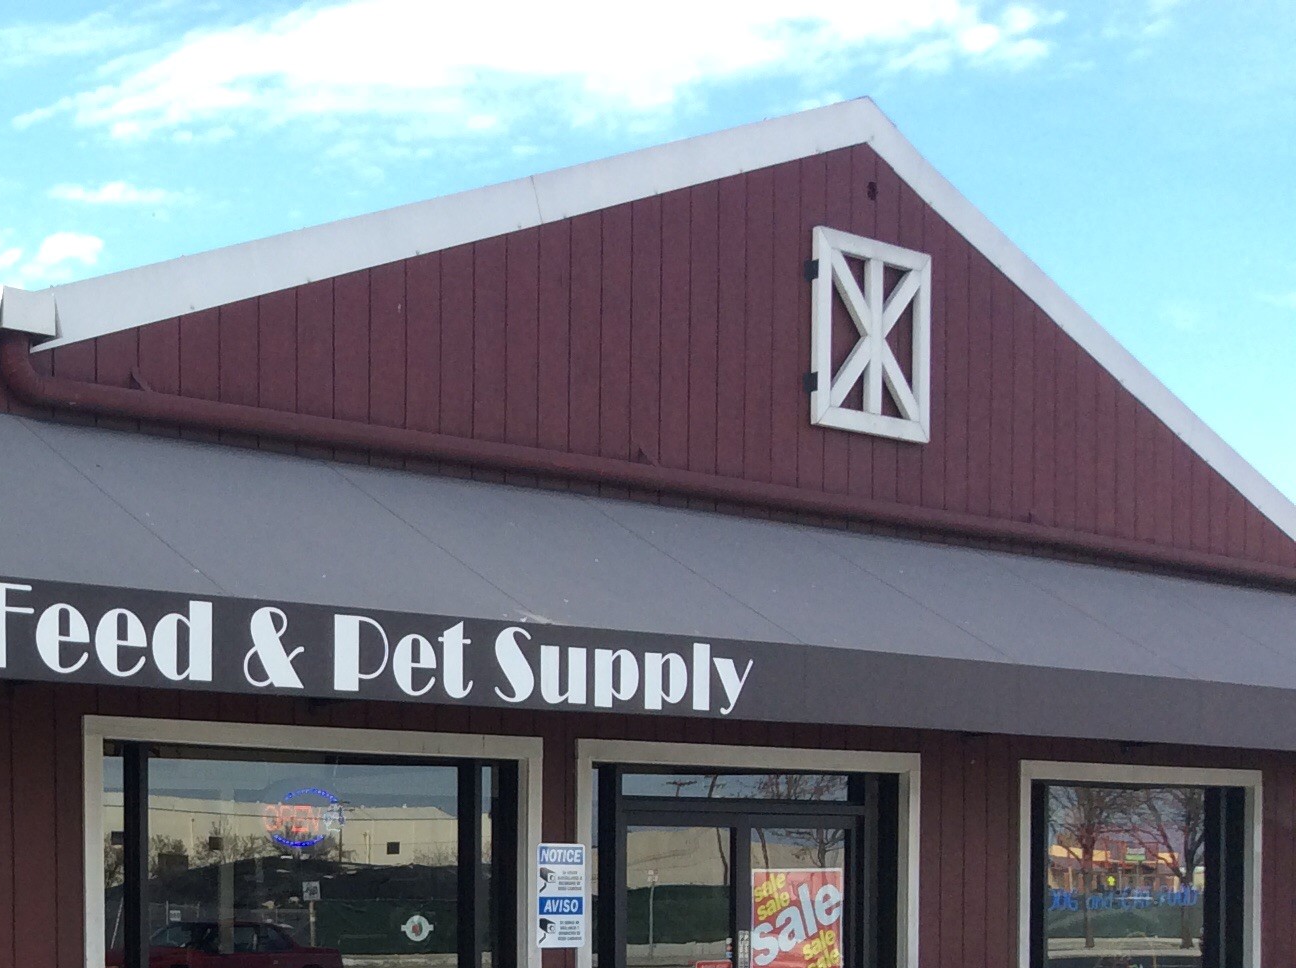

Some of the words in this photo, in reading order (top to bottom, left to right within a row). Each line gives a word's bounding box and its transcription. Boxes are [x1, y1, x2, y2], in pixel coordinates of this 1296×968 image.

[243, 607, 304, 688] &
[334, 614, 472, 698] Pet
[494, 626, 754, 714] Supply
[540, 848, 581, 863] NOTICE
[754, 872, 786, 902] sale
[543, 899, 579, 913] AVISO
[757, 891, 790, 921] sale
[751, 883, 842, 966] sale
[803, 929, 836, 960] sale
